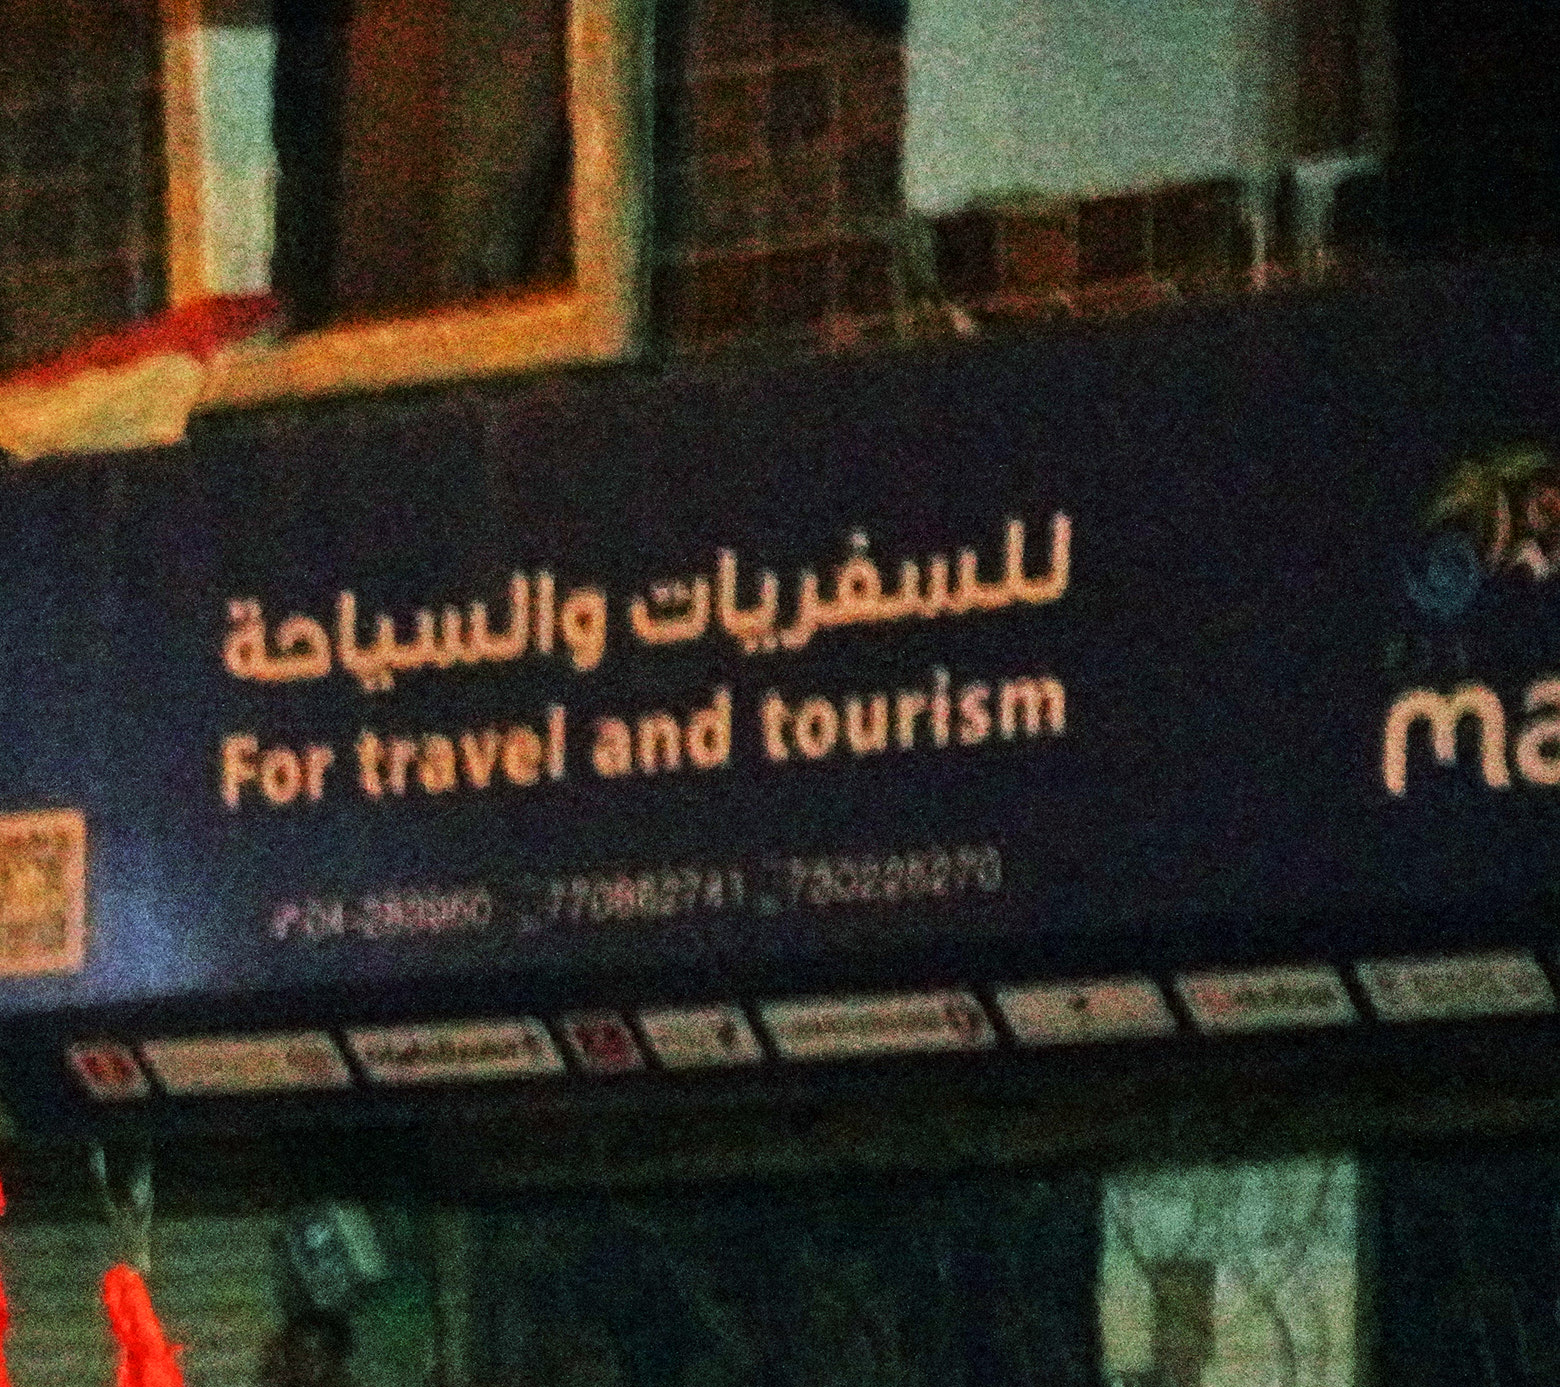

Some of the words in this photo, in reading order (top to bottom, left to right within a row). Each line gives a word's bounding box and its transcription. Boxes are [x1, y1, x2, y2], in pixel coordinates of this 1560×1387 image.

[220, 570, 608, 694] والسياحة
[626, 508, 1076, 650] للسفريات
[218, 728, 338, 810] For
[356, 703, 566, 802] travel
[591, 688, 733, 774] and
[761, 664, 1068, 760] tourism
